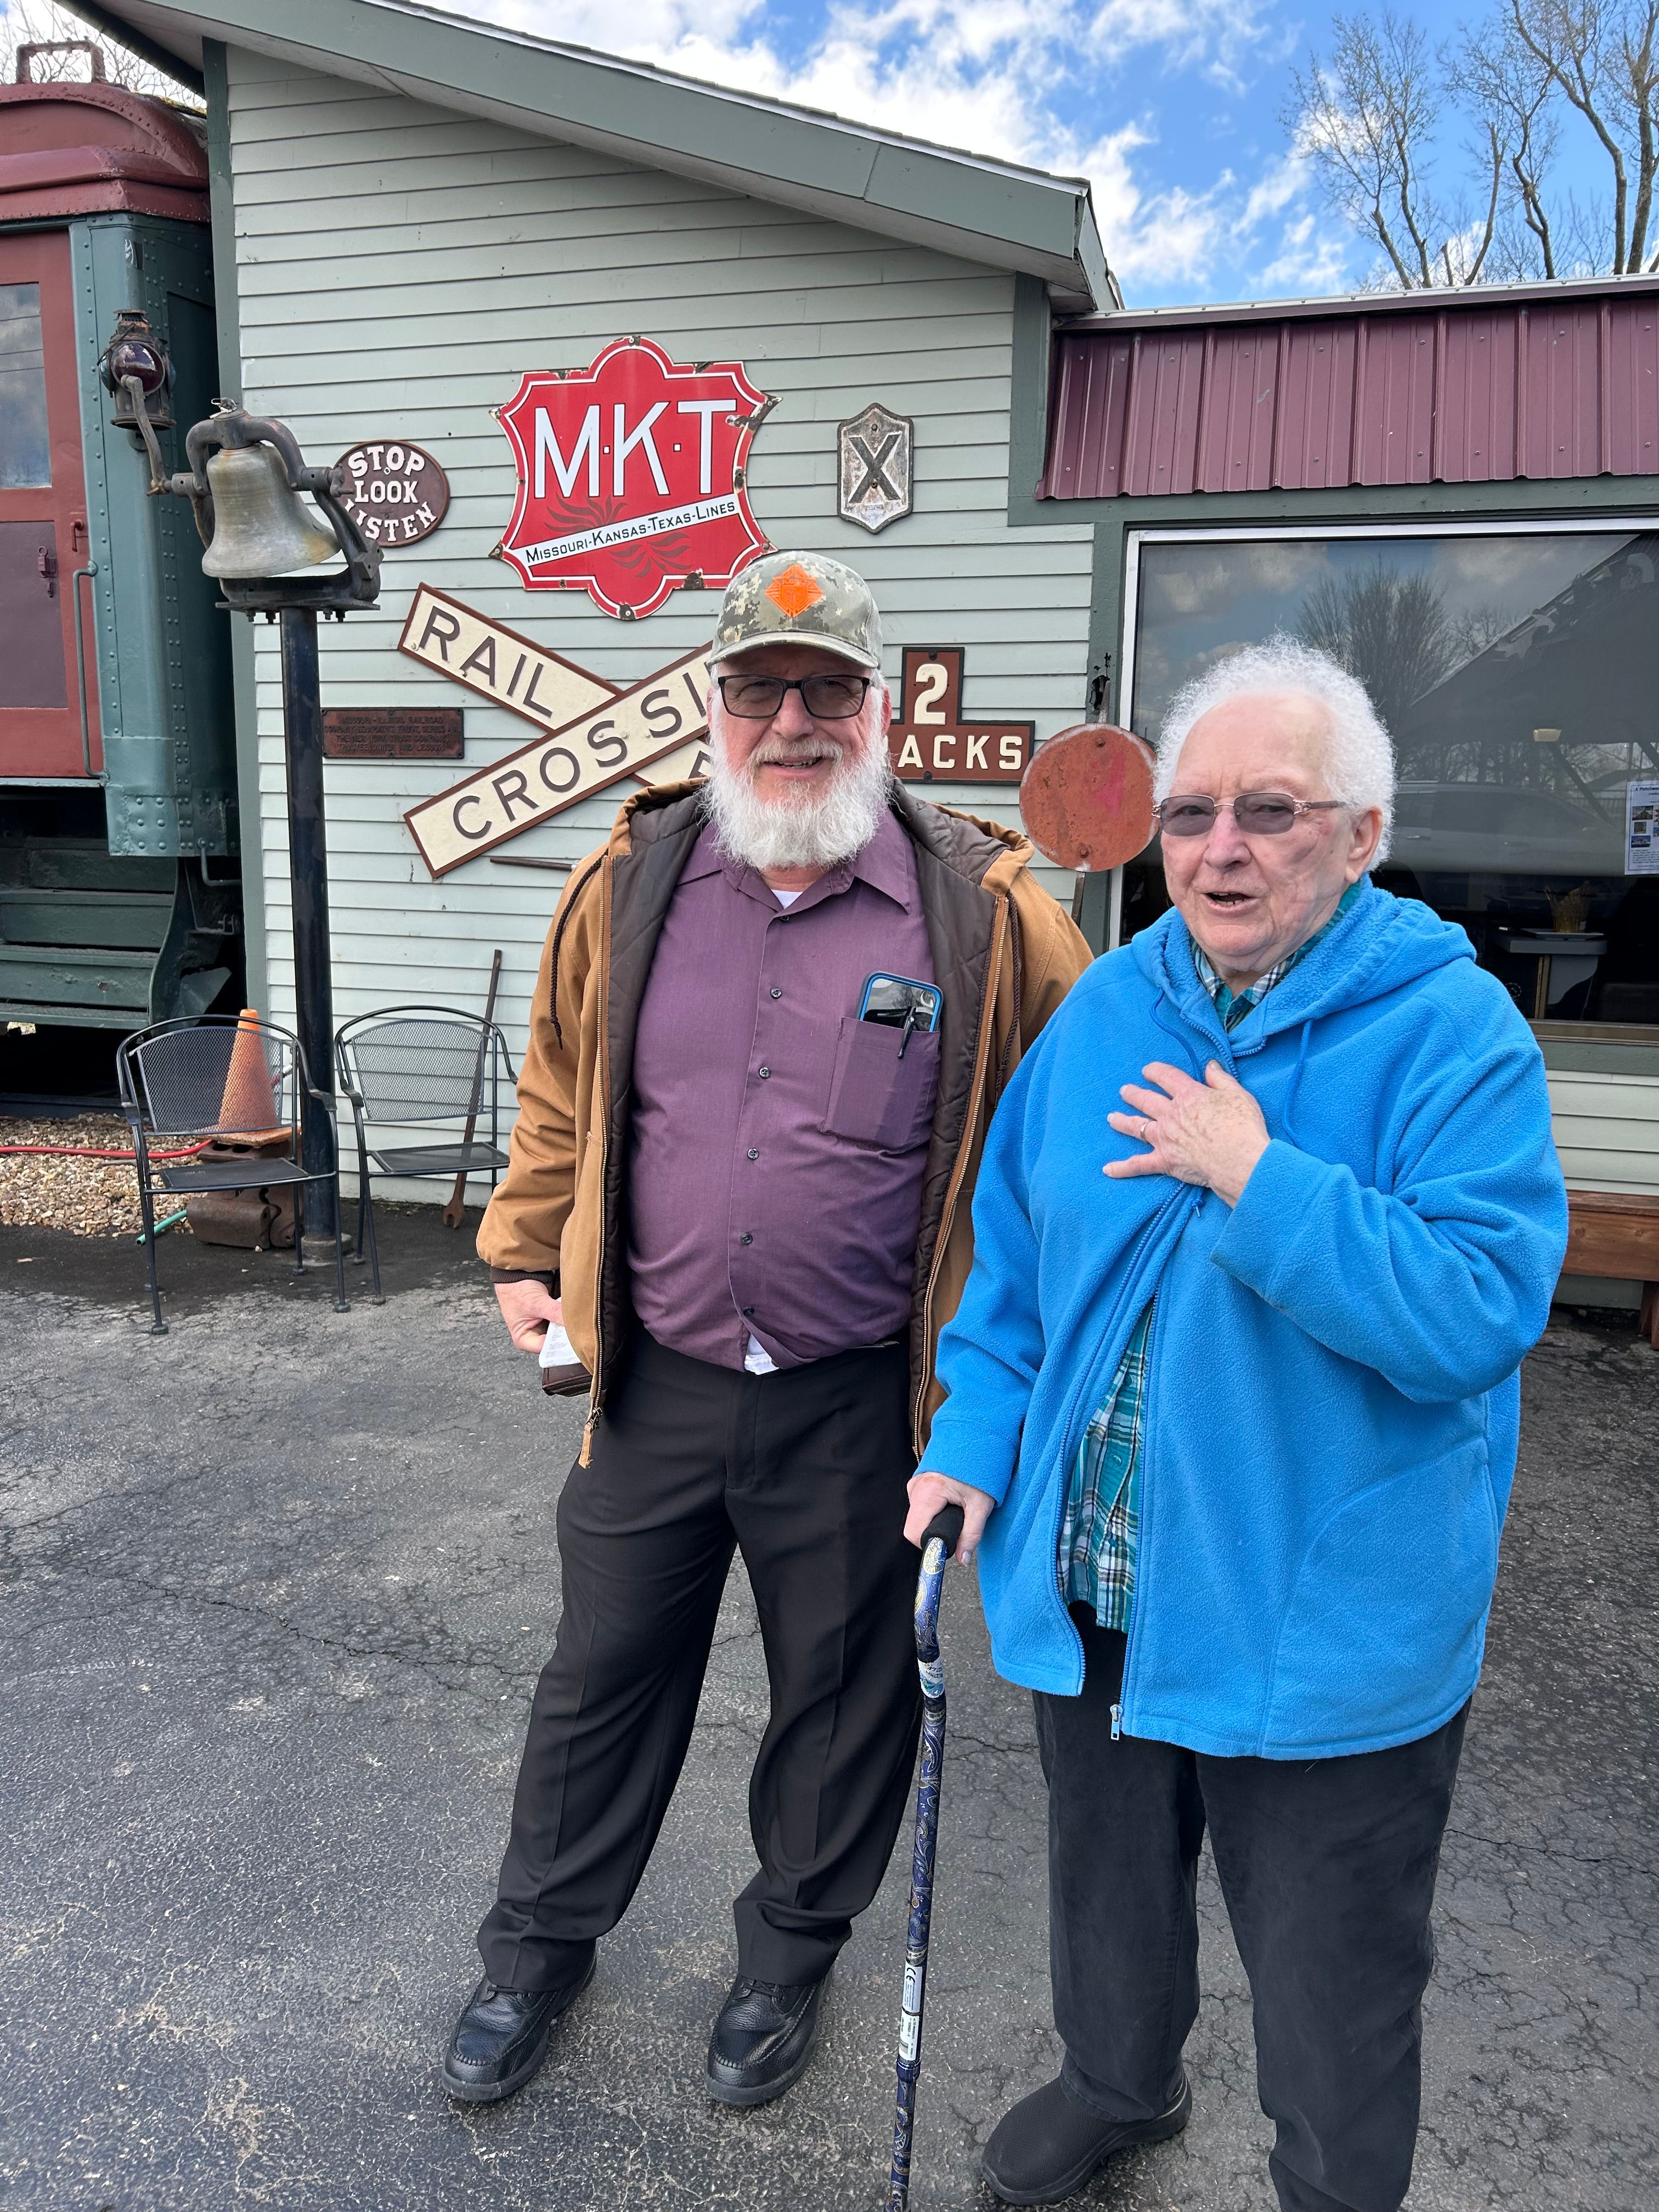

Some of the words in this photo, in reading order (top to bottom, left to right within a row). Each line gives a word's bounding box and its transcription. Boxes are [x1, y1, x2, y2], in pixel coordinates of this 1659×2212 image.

[348, 445, 425, 478] STOP
[354, 480, 418, 504] LOOK
[848, 431, 902, 505] X
[419, 605, 554, 719] RAIL
[913, 663, 949, 725] 2
[453, 661, 712, 839] CROSSI
